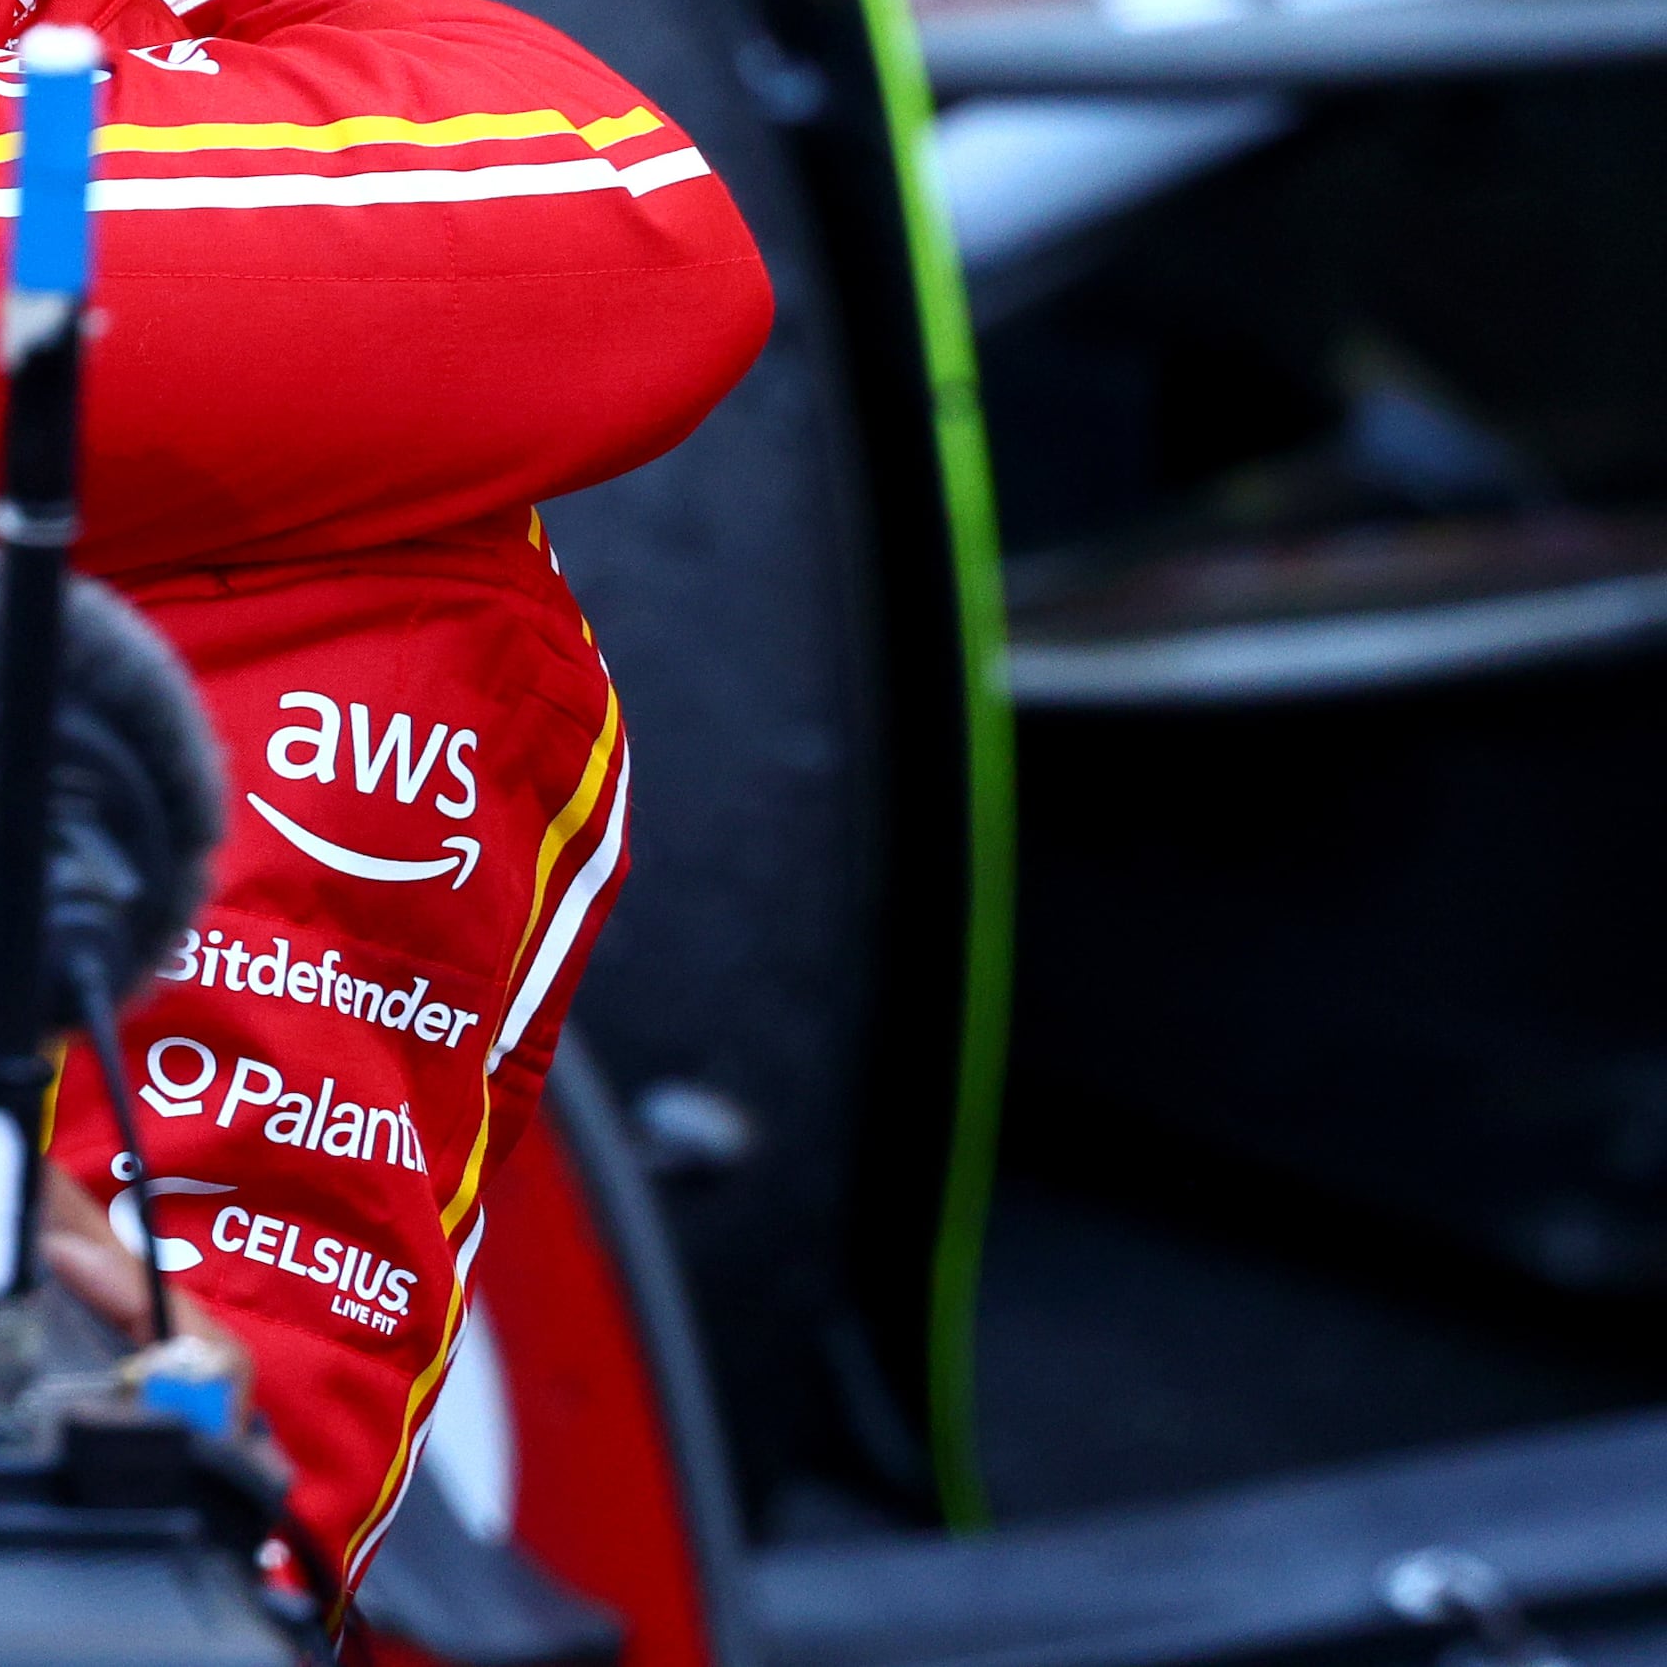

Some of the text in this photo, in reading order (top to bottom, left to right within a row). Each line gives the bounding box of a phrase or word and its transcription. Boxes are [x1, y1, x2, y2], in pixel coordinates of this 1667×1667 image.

[266, 690, 479, 821] aws
[155, 928, 480, 1049] Bitdefender
[330, 1294, 398, 1336] LIVE FIT
